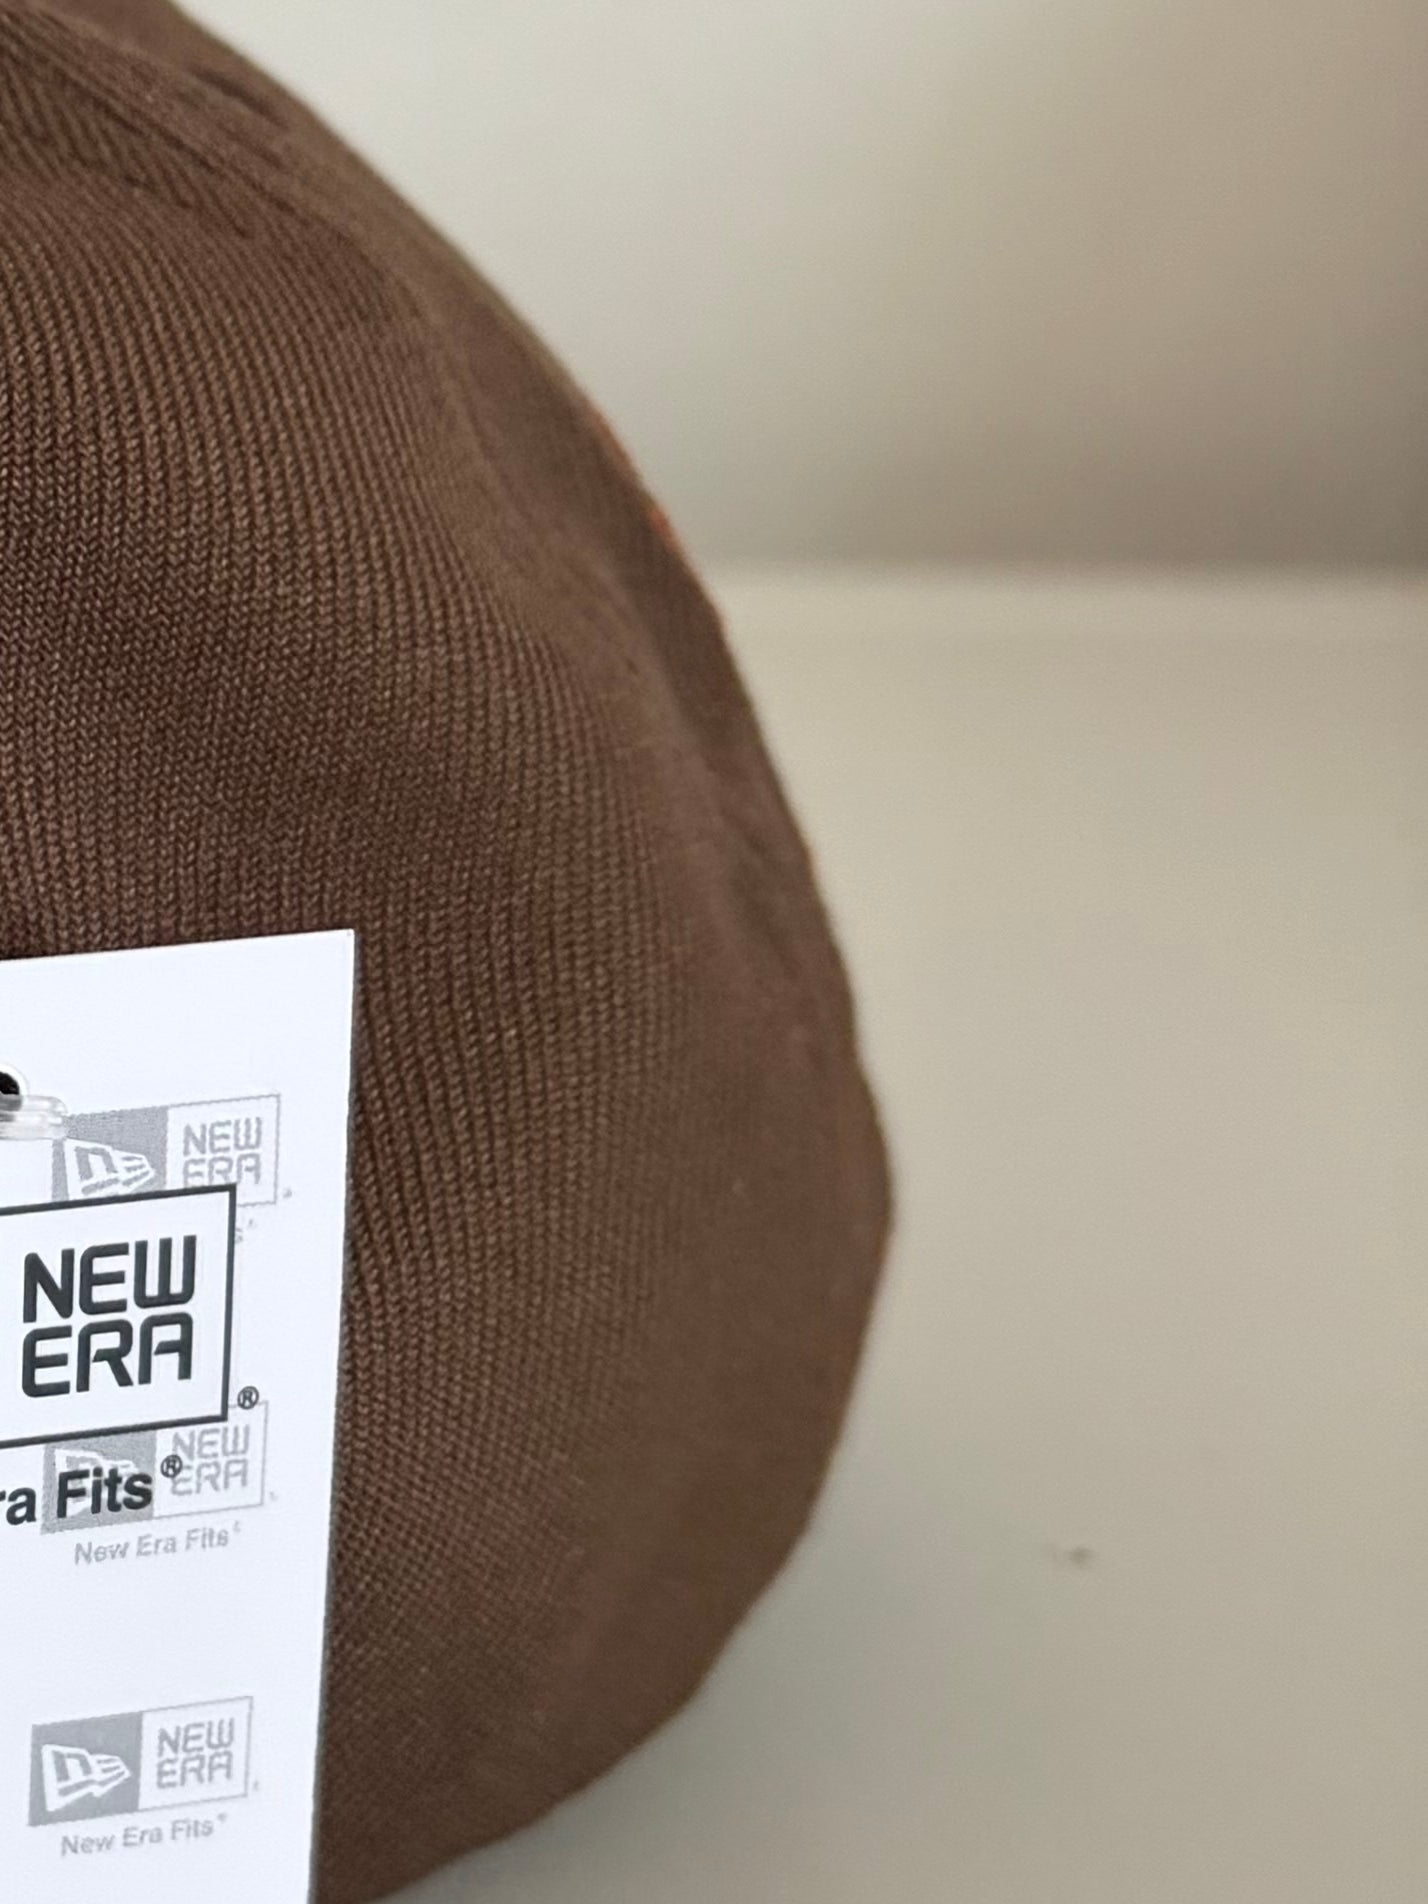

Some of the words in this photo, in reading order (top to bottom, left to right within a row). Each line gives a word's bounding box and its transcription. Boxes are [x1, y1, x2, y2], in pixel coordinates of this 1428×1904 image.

[183, 1117, 262, 1156] NEW
[22, 1234, 197, 1324] NEW
[21, 1312, 194, 1398] ERA
[172, 1424, 251, 1462] NEW
[75, 1541, 130, 1566] New
[136, 1534, 177, 1557] Era
[157, 1716, 235, 1758] NEW
[156, 1750, 234, 1789] ERA
[61, 1833, 116, 1857] New
[122, 1825, 164, 1848] Era
